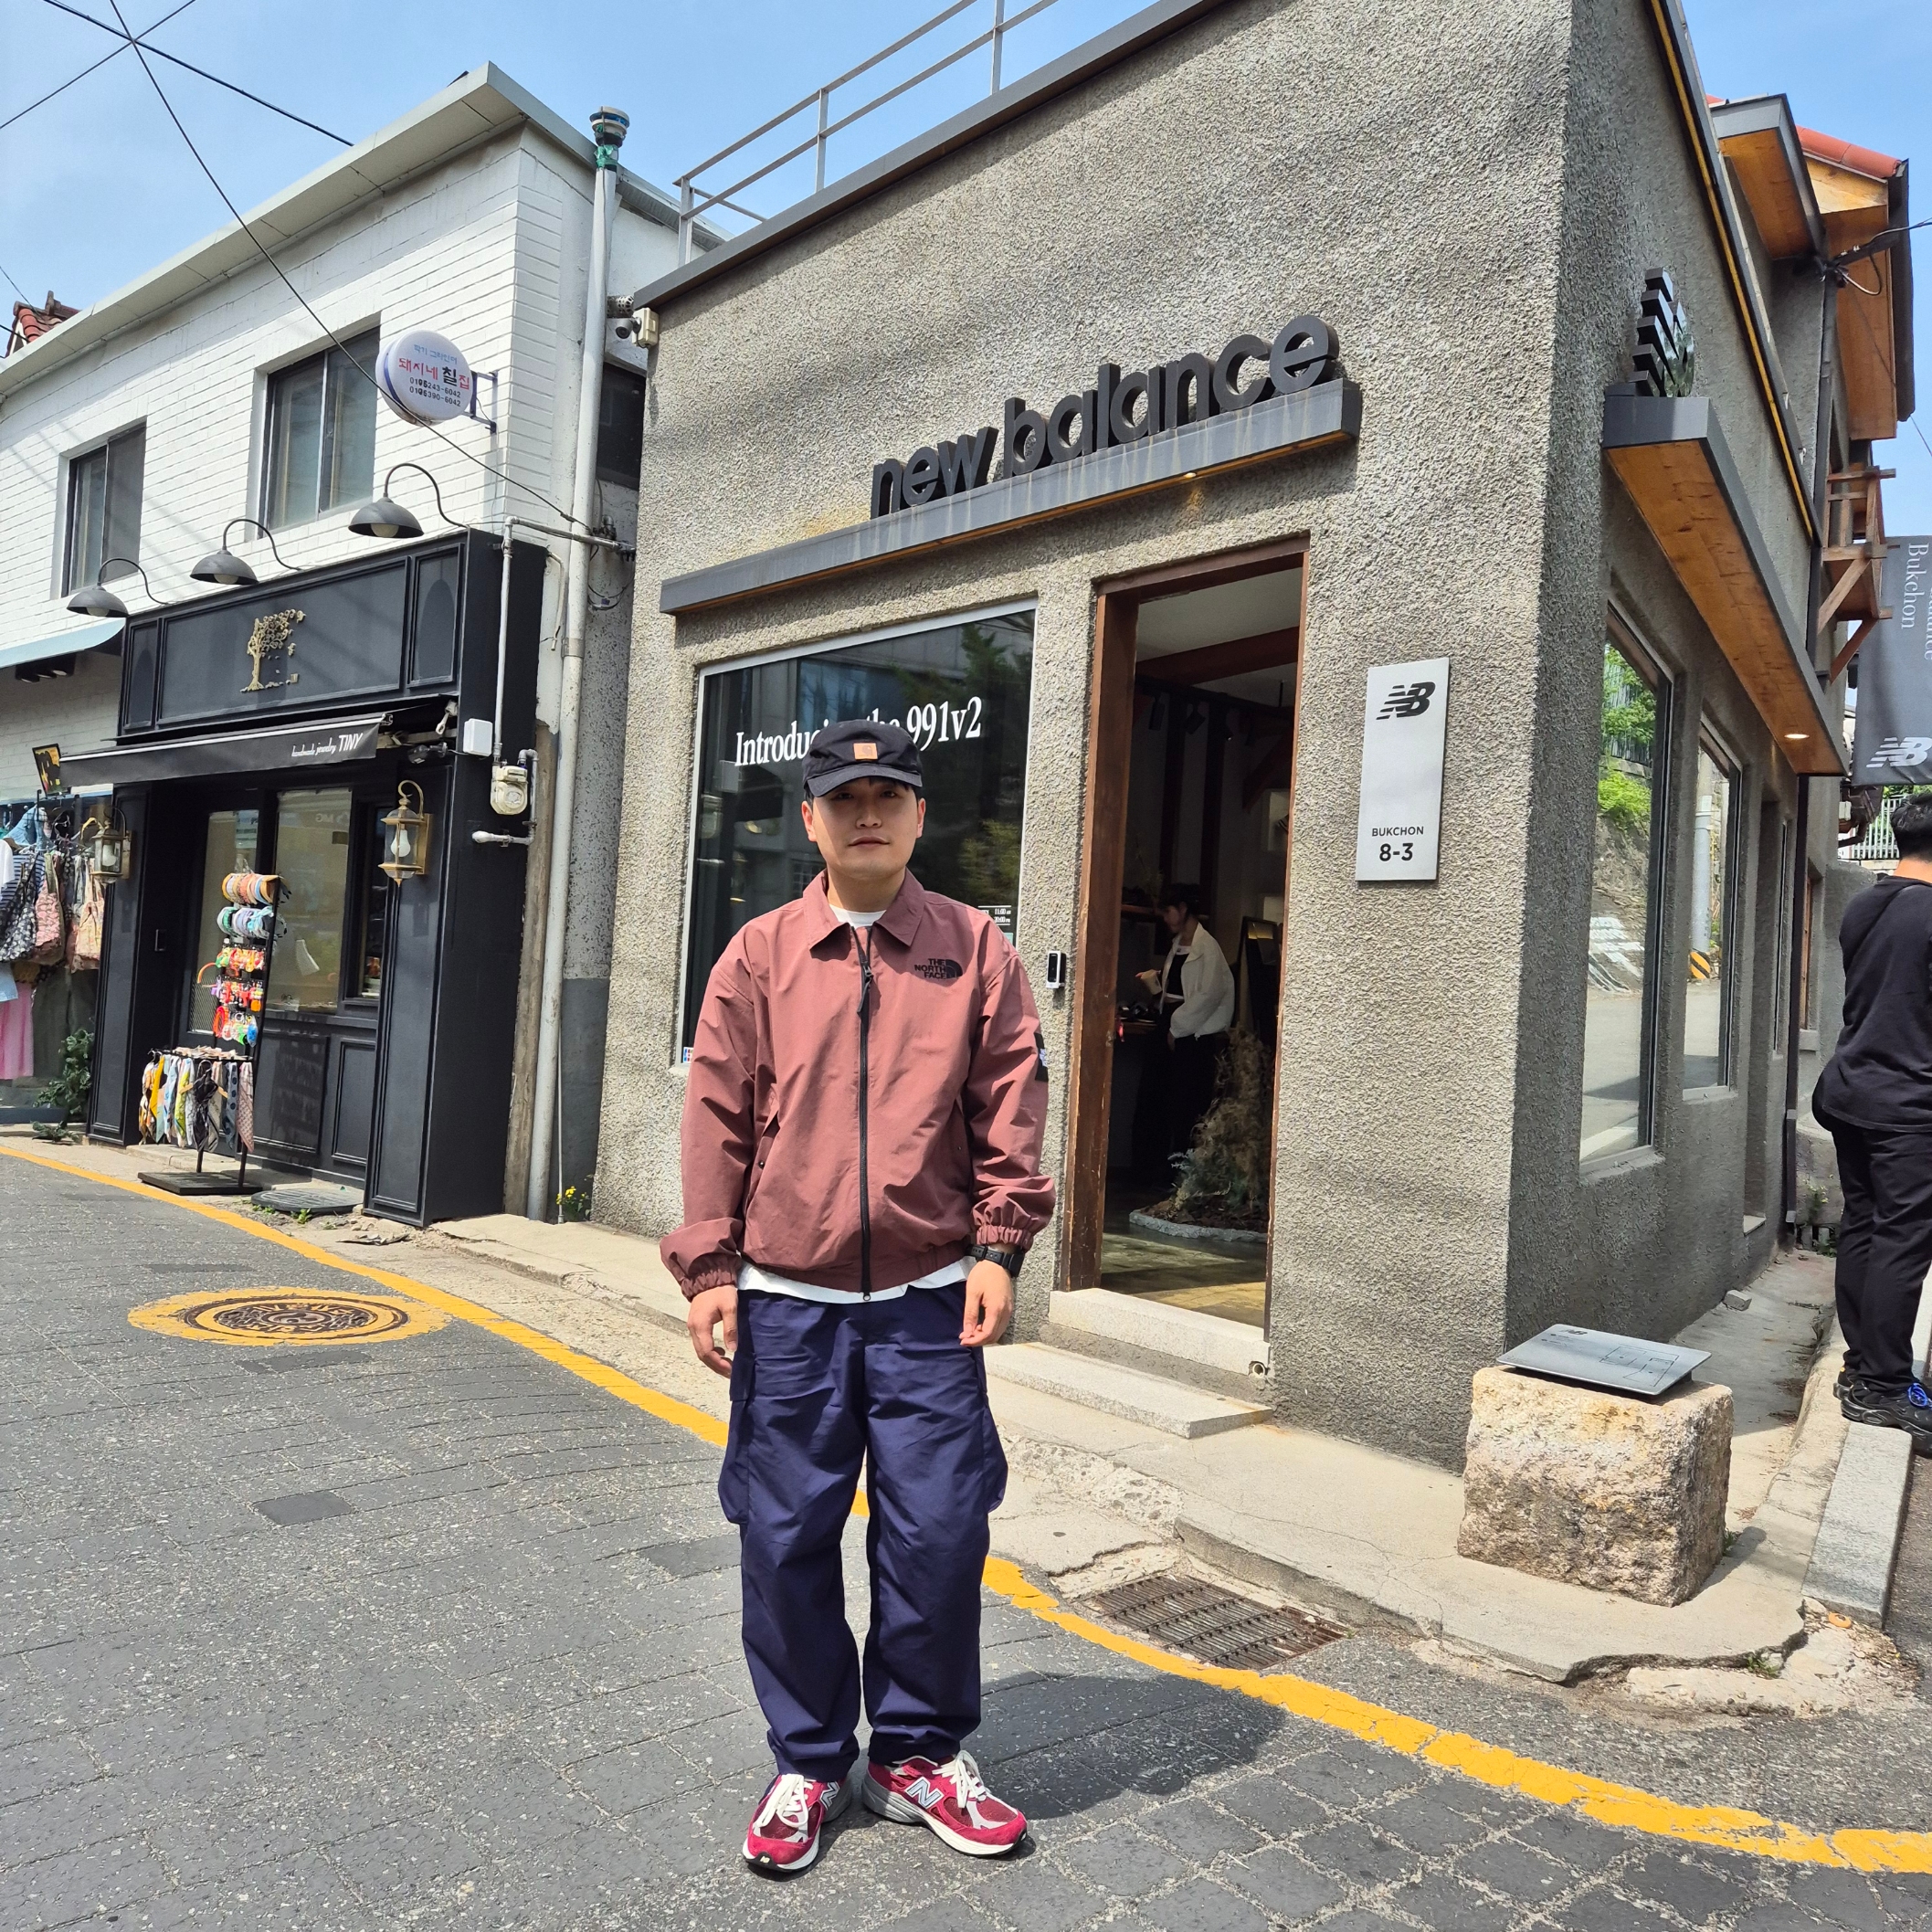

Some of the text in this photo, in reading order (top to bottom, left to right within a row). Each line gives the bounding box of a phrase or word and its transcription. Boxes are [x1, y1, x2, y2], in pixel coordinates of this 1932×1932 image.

[399, 358, 438, 380] 돼지네
[871, 315, 1339, 520] new balance
[1901, 543, 1929, 629] Bukchon
[907, 696, 982, 751] 991v2
[339, 733, 364, 752] TINY
[1372, 826, 1424, 837] BUKCHON
[1379, 842, 1414, 861] 8-3
[914, 965, 945, 973] NORTH
[905, 1777, 944, 1809] N
